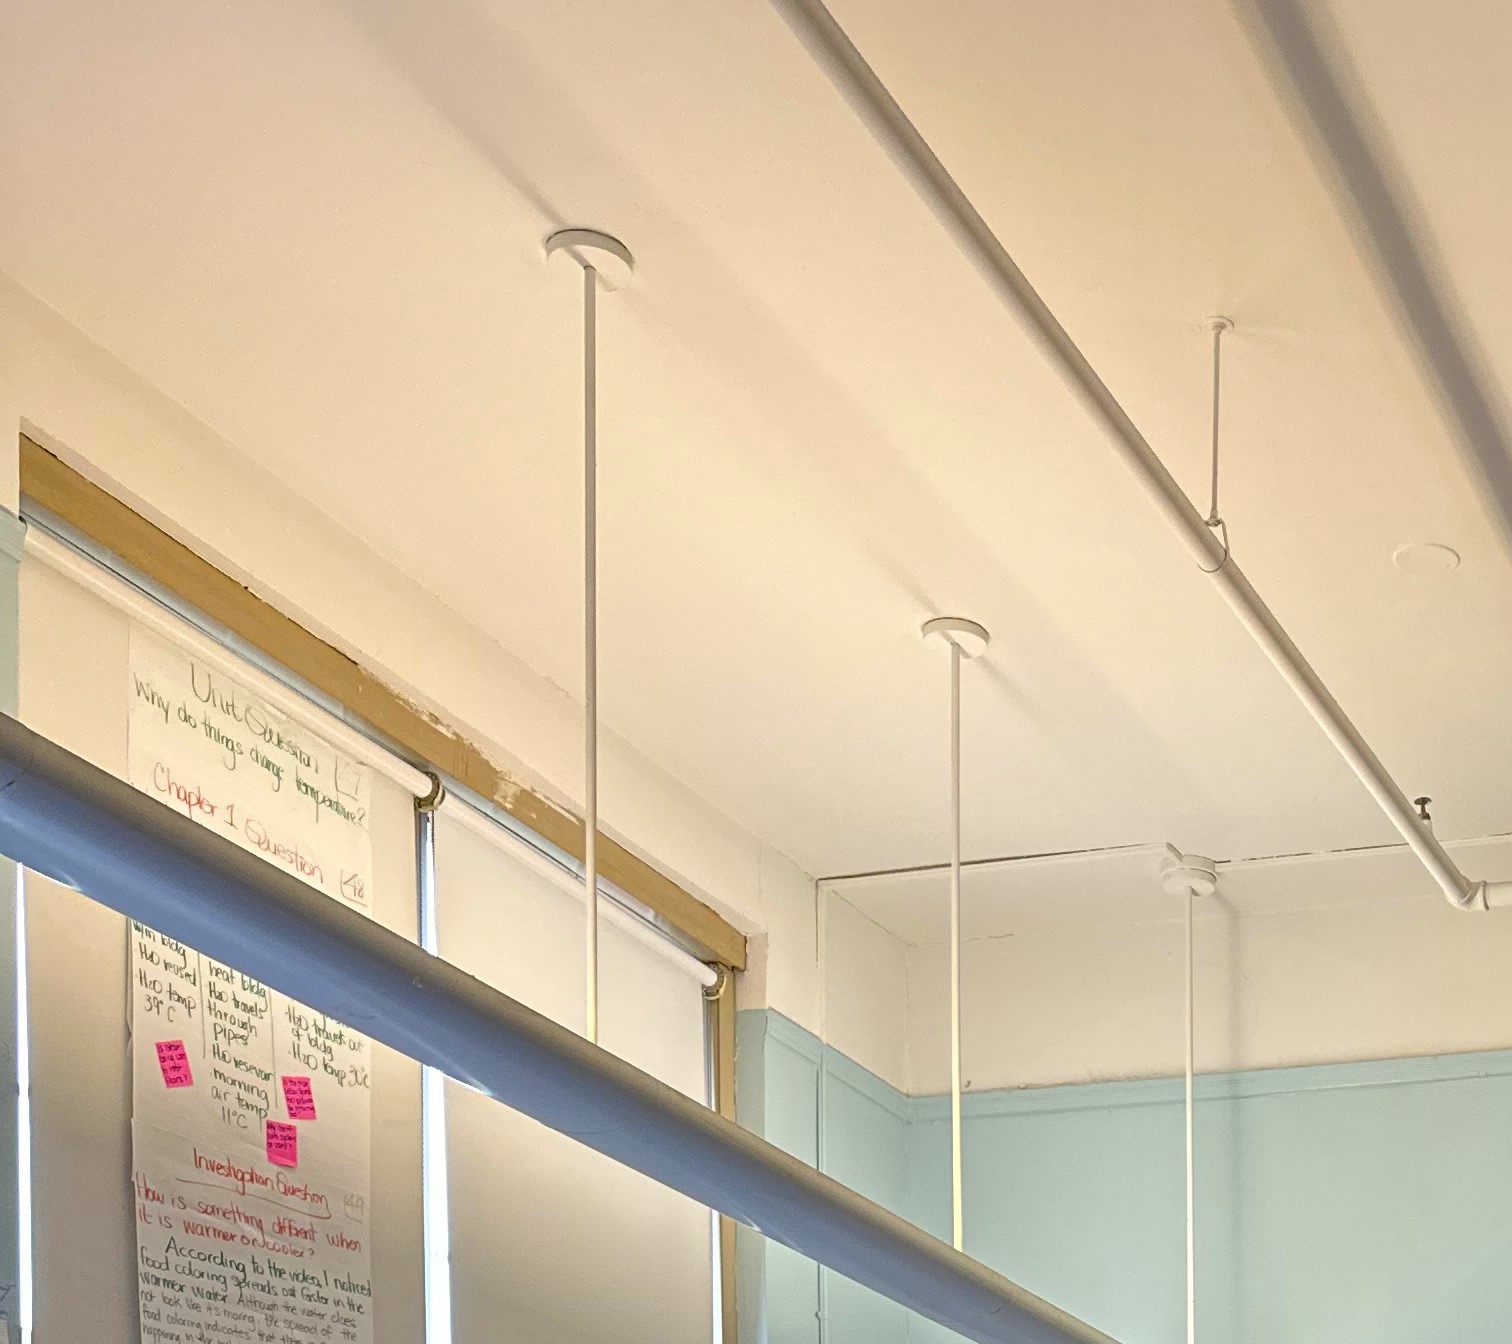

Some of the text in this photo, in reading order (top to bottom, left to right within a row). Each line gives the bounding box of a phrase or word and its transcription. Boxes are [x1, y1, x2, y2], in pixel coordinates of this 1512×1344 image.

[134, 673, 243, 771] Why do things
[153, 762, 323, 884] Chapter 1 Question
[213, 1068, 270, 1110] morning
[159, 1213, 236, 1245] is warmer
[171, 1194, 263, 1242] is something
[165, 1236, 372, 1297] According to the noticed
[175, 1261, 228, 1291] coloring
